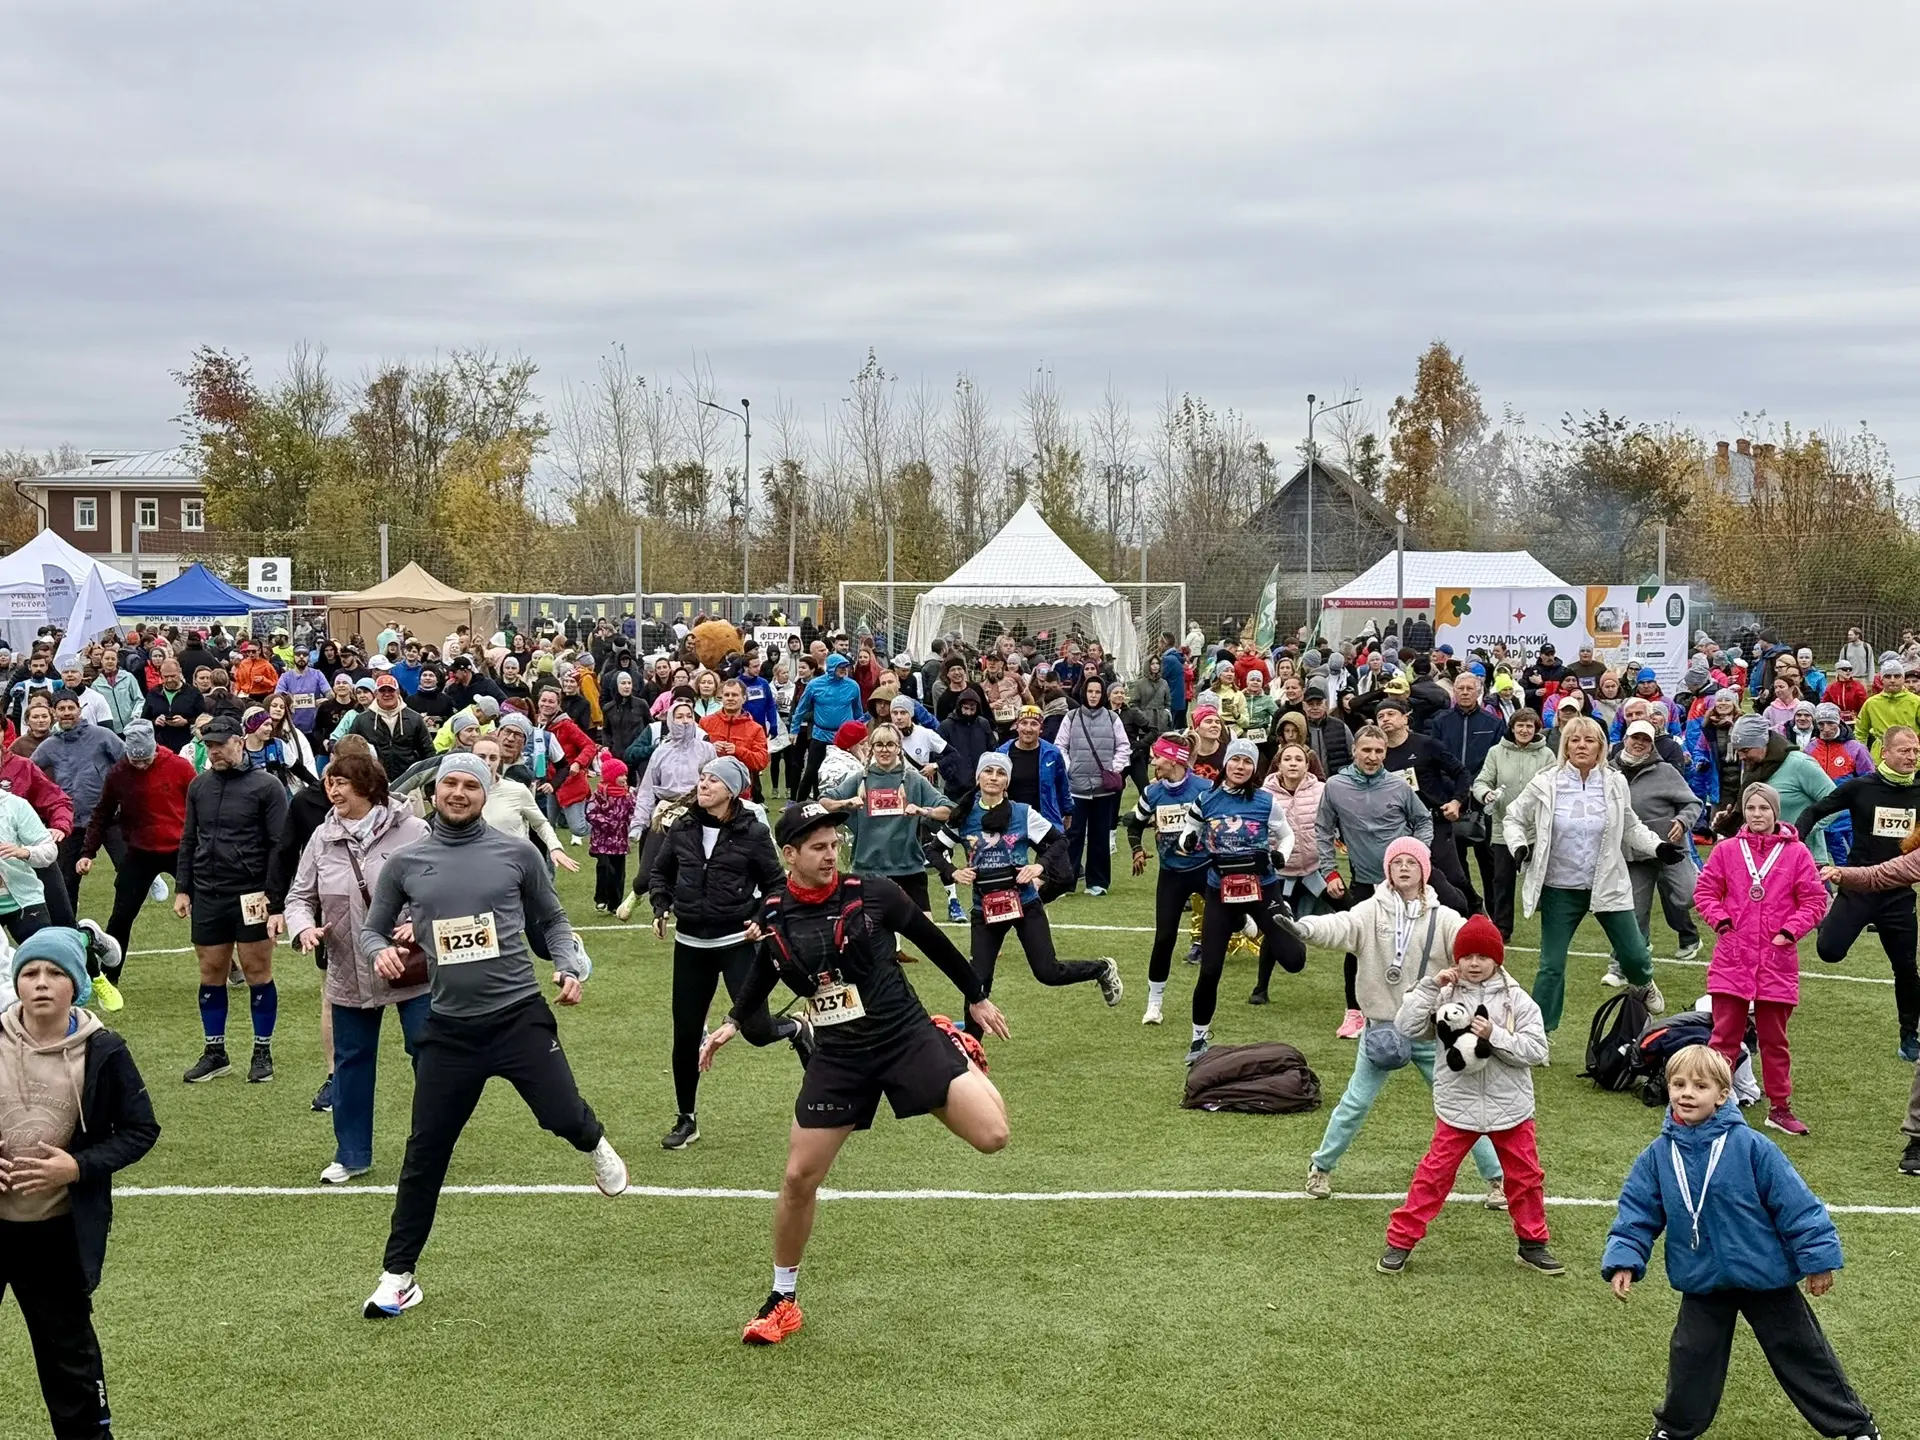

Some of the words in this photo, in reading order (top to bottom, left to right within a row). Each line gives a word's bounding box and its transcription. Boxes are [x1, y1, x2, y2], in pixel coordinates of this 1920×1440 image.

[261, 562, 278, 582] 2
[760, 632, 793, 641] ФЕРМ
[1468, 633, 1549, 646] СУЗДАЛЬСКИЙ
[875, 799, 899, 808] 924
[1880, 818, 1911, 829] 1370
[442, 931, 488, 951] 1236
[811, 991, 848, 1013] 1237
[95, 1379, 107, 1408] FILA
